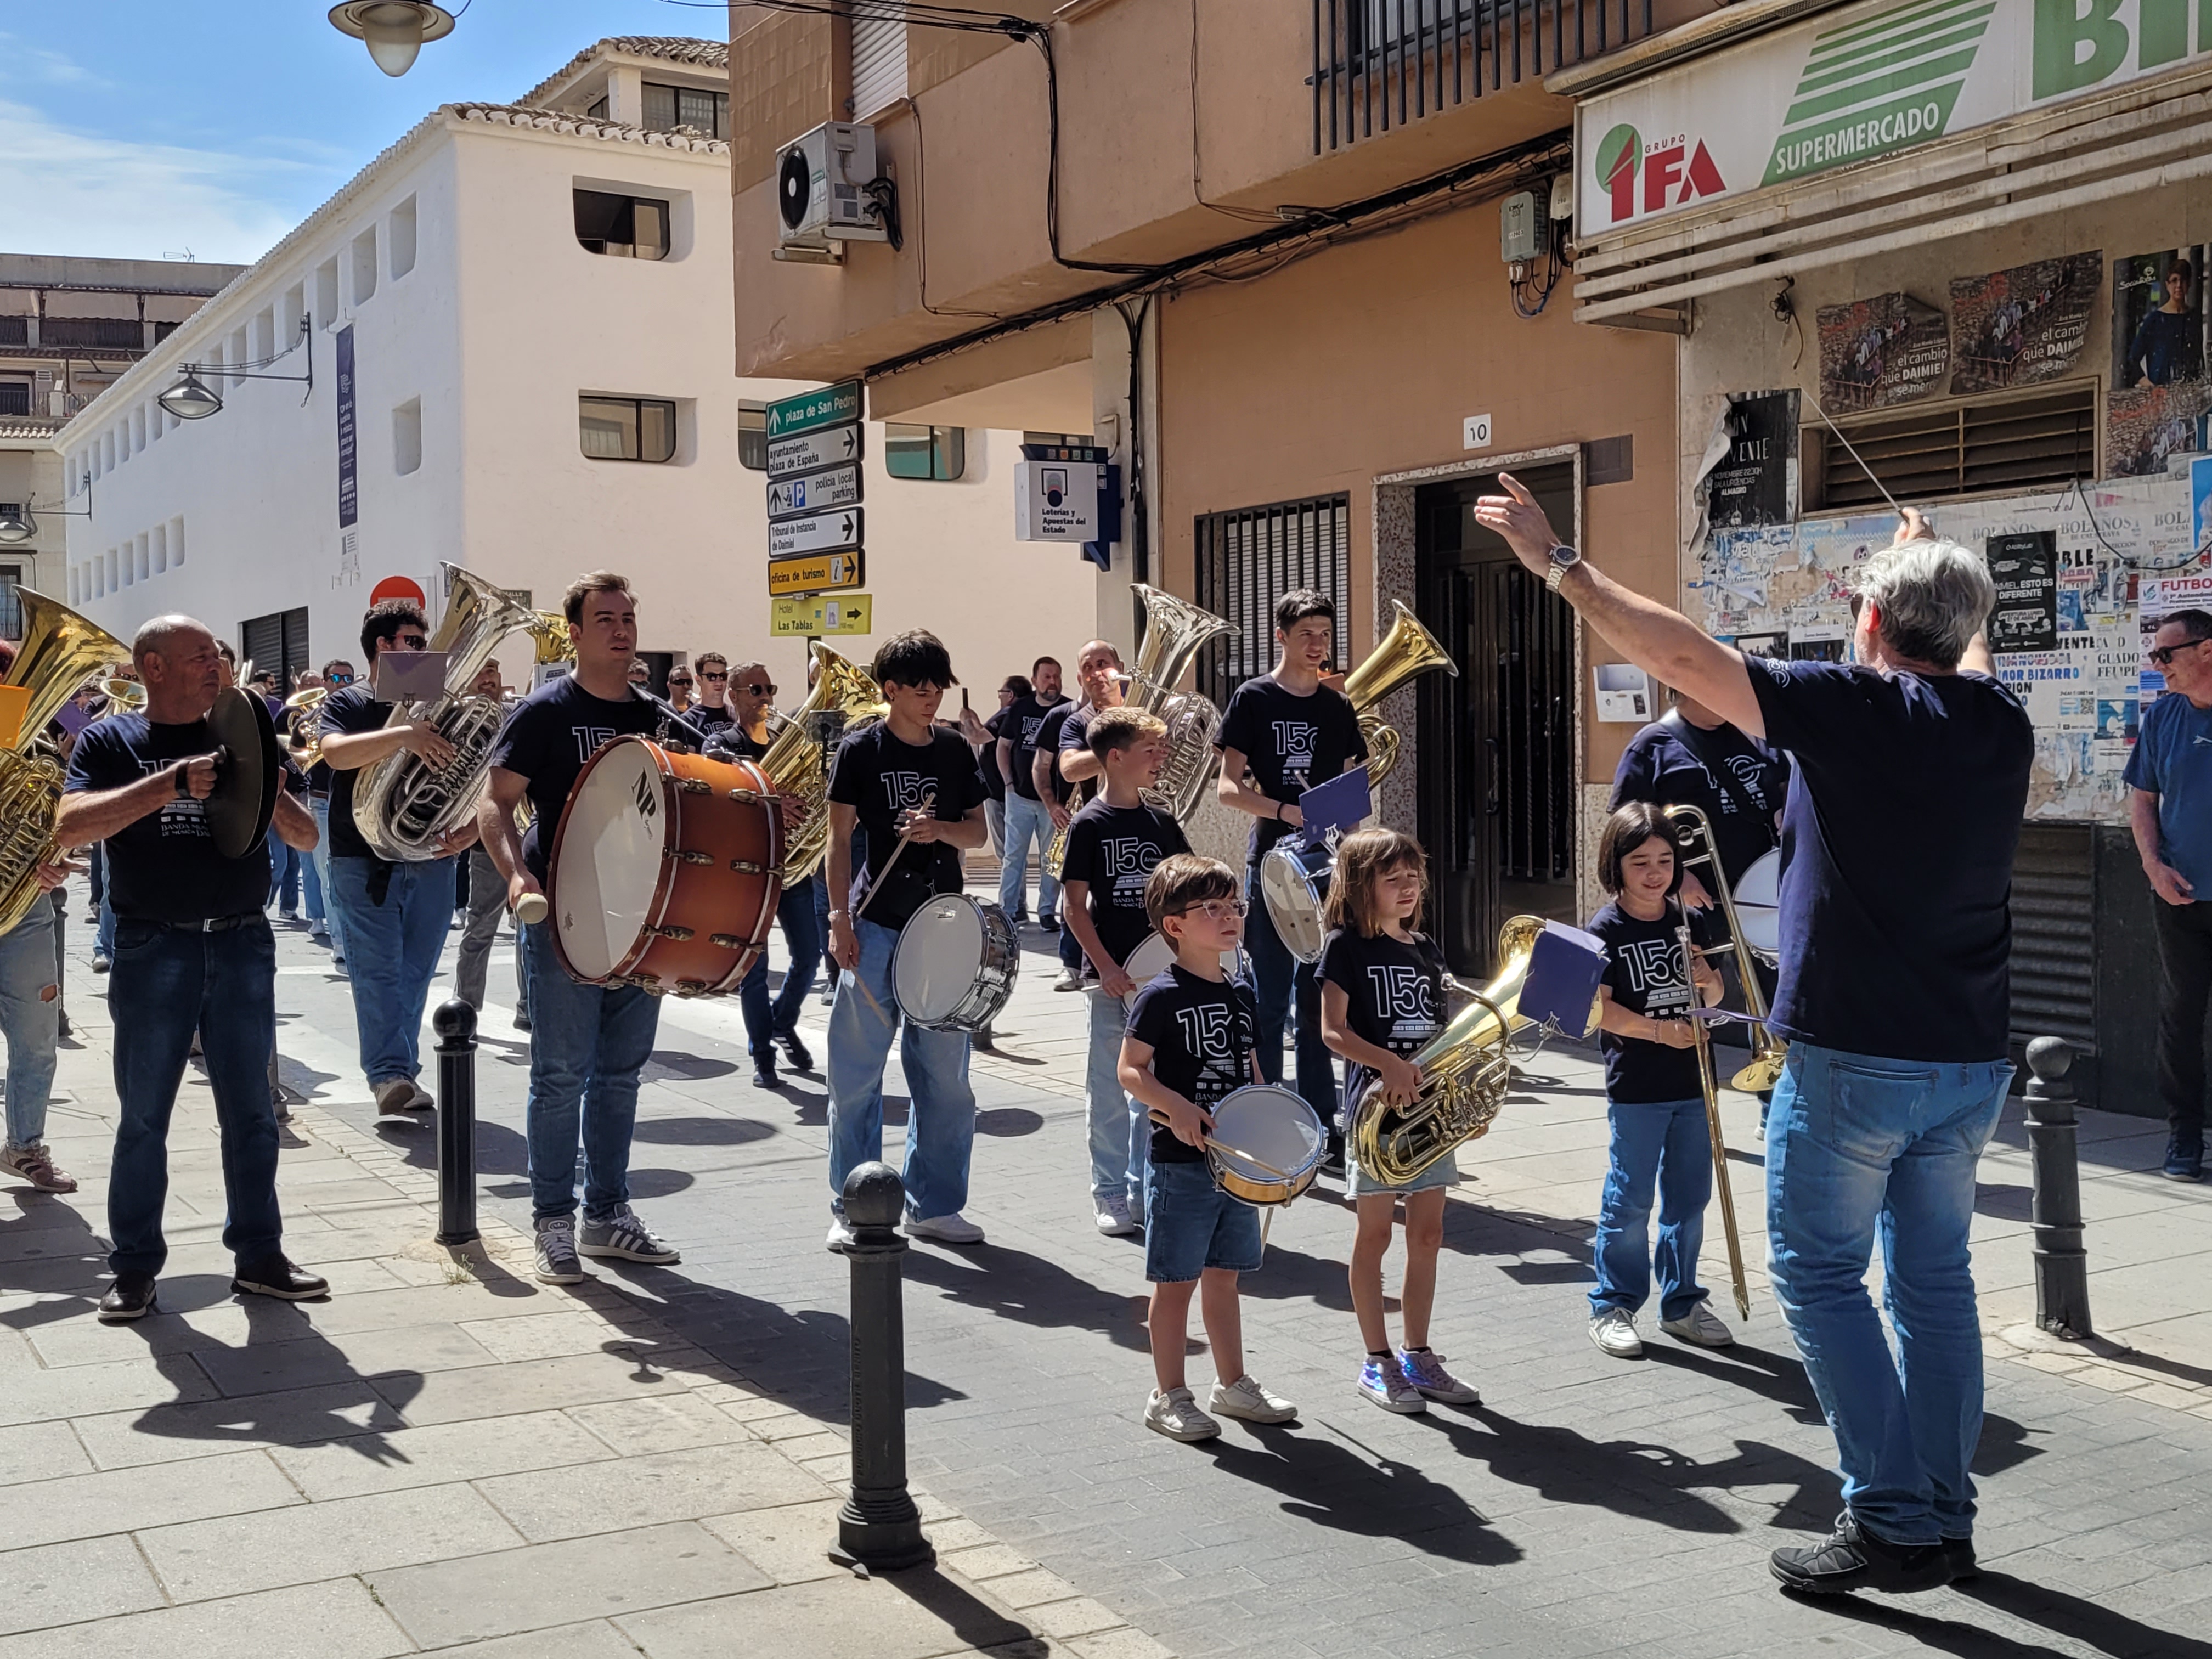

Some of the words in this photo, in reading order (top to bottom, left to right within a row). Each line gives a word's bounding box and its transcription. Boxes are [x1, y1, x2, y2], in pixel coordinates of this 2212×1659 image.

[1645, 134, 1686, 153] GRUPO
[1775, 102, 1940, 174] SUPERMERCADO
[2042, 327, 2052, 341] el
[1898, 354, 1907, 366] el
[1909, 347, 1948, 364] cambio
[2023, 348, 2044, 363] que
[1881, 373, 1900, 387] que
[786, 409, 804, 426] plaza
[806, 405, 815, 417] de
[817, 400, 832, 414] San
[834, 395, 855, 410] Pedro
[1470, 424, 1487, 441] 10
[770, 440, 809, 461] ayuntamiento
[770, 459, 785, 475] plaza
[787, 458, 795, 468] de
[797, 453, 819, 467] España
[838, 471, 854, 485] local
[832, 484, 855, 502] parking
[1721, 486, 1747, 496] ALMAGRO
[1042, 517, 1074, 526] Apuestas
[771, 524, 789, 537] Tribunal
[789, 524, 795, 534] de
[796, 521, 817, 533] Instancia
[772, 540, 777, 551] de
[778, 538, 794, 550] Daimiel
[2055, 549, 2094, 568] BLE
[771, 572, 790, 584] oficina
[793, 571, 800, 580] de
[803, 568, 825, 580] turismo
[2021, 579, 2041, 589] ESTO
[2042, 578, 2053, 587] ES
[2162, 578, 2212, 592] FUTBO
[1999, 588, 2042, 600] DIFERENTE
[778, 603, 793, 614] Hotel
[778, 620, 789, 630] Las
[791, 619, 813, 630] Tablas
[2028, 667, 2079, 681] BIZARRO
